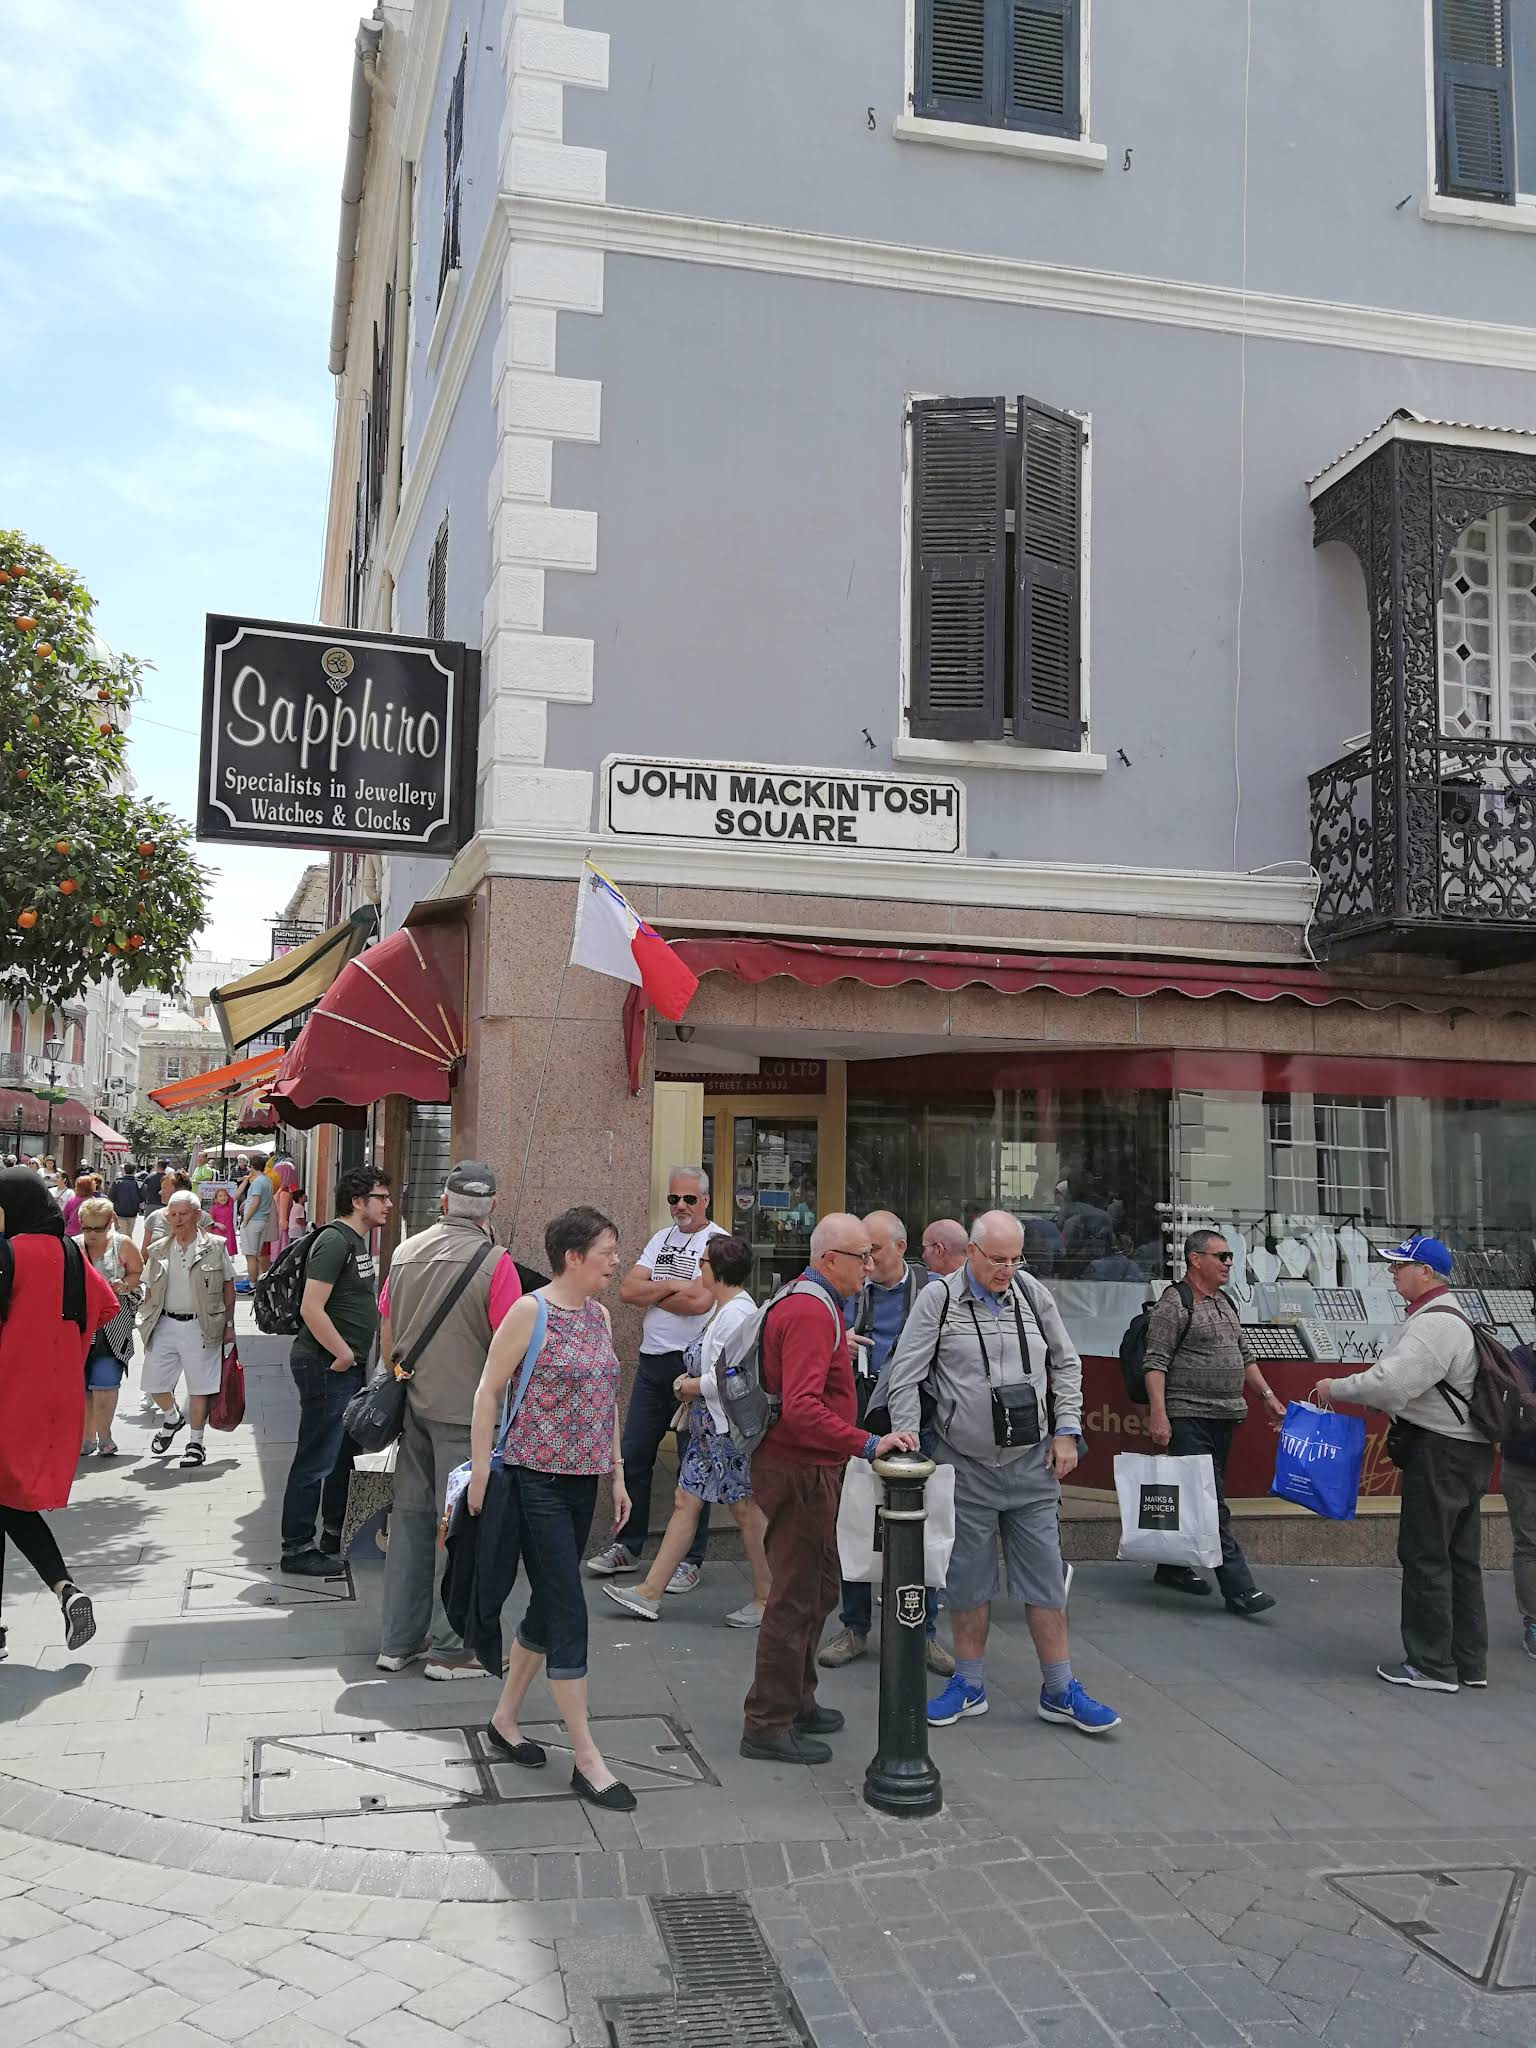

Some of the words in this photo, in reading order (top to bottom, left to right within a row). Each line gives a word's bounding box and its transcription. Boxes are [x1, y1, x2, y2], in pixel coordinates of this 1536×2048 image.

[226, 664, 440, 772] Sapphiro
[225, 767, 322, 796] Specialists
[330, 777, 346, 798] in
[355, 779, 437, 811] Jewellery
[617, 769, 717, 801] JOHN
[730, 775, 953, 817] MACKINTOSH
[251, 798, 324, 825] Watches
[332, 804, 346, 827] &
[355, 806, 411, 832] Clocks
[714, 808, 857, 843] SQUARE
[790, 1061, 820, 1077] LTD
[1280, 1303, 1301, 1312] SALE
[1082, 1403, 1152, 1437] ches
[1142, 1504, 1176, 1512] SPENCER
[1144, 1495, 1167, 1503] MARKS
[1168, 1496, 1175, 1504] &
